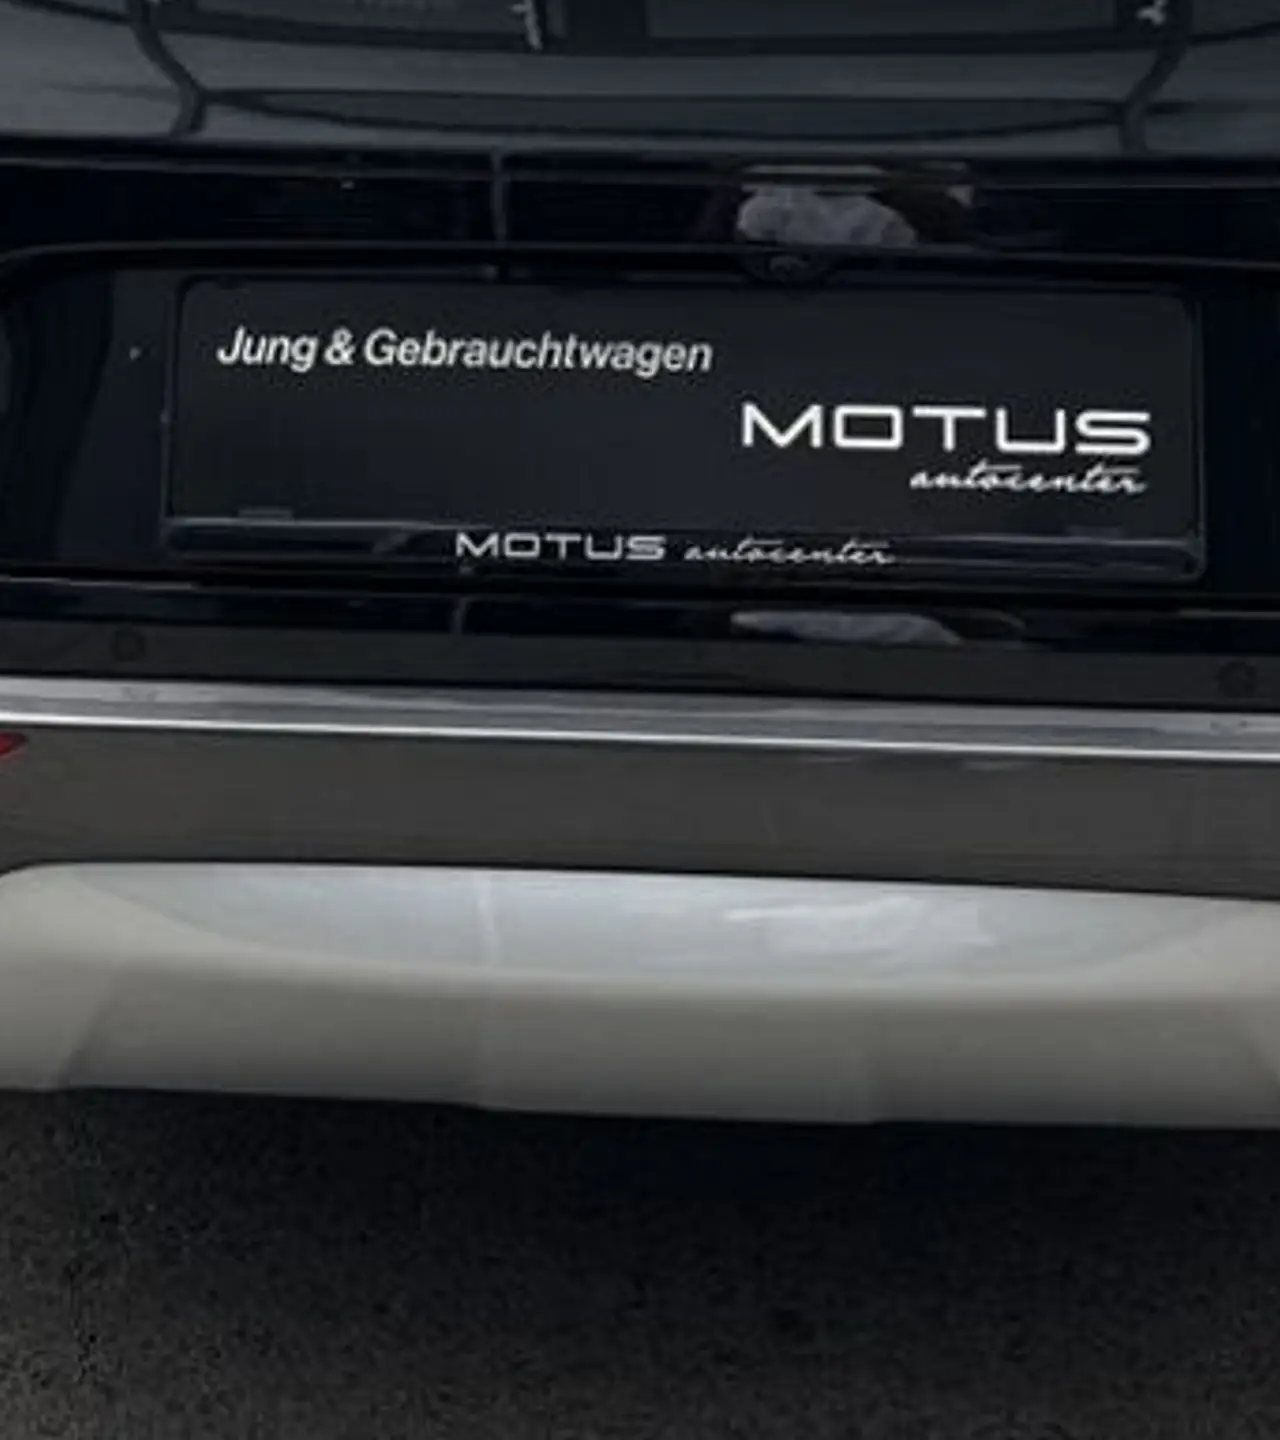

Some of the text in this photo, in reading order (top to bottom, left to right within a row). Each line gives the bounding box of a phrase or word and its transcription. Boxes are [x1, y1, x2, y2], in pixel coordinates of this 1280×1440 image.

[217, 326, 715, 378] Jung & Gebrauchtwagen
[741, 402, 1152, 455] MOTUS
[909, 459, 1148, 494] autocenter
[455, 532, 898, 565] MOTUS autocenter
